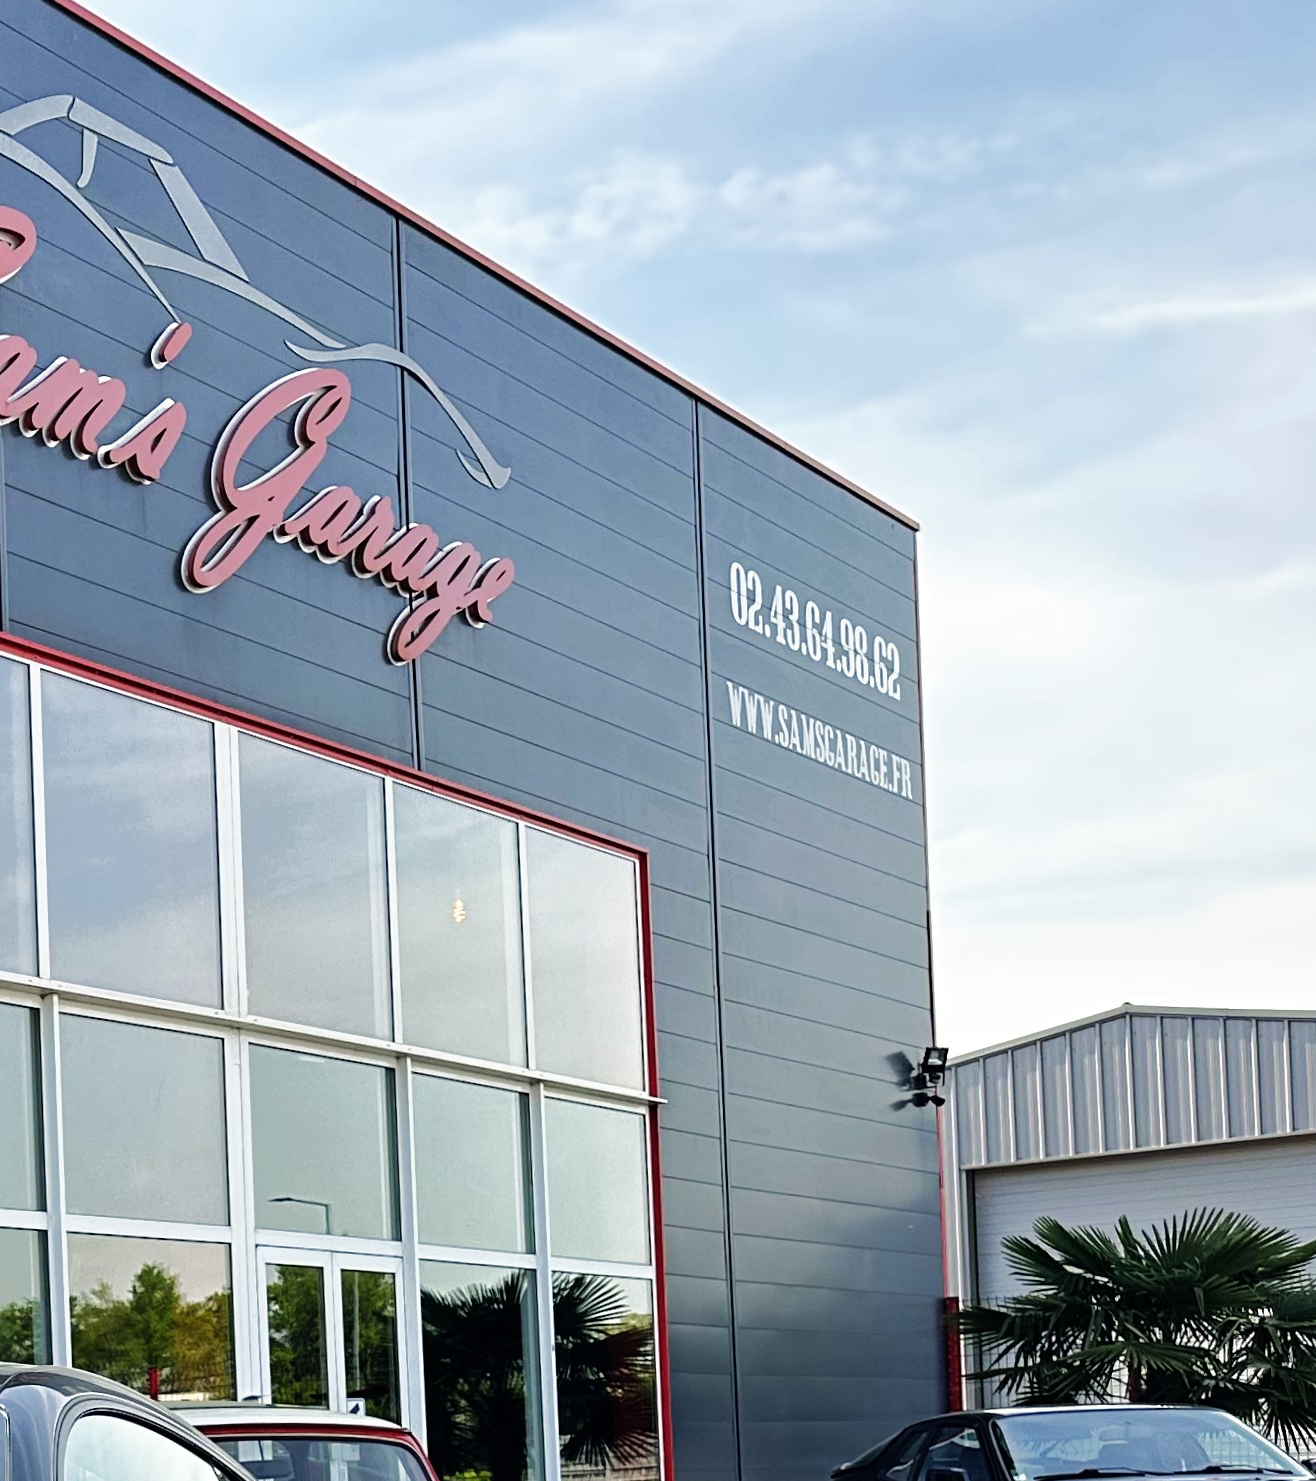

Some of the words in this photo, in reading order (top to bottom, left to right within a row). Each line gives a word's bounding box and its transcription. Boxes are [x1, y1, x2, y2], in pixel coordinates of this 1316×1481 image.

[179, 368, 515, 667] Garage
[729, 561, 902, 701] 02.43.64.98.62
[726, 681, 914, 800] WWW.SAMSGARAGE.FR
